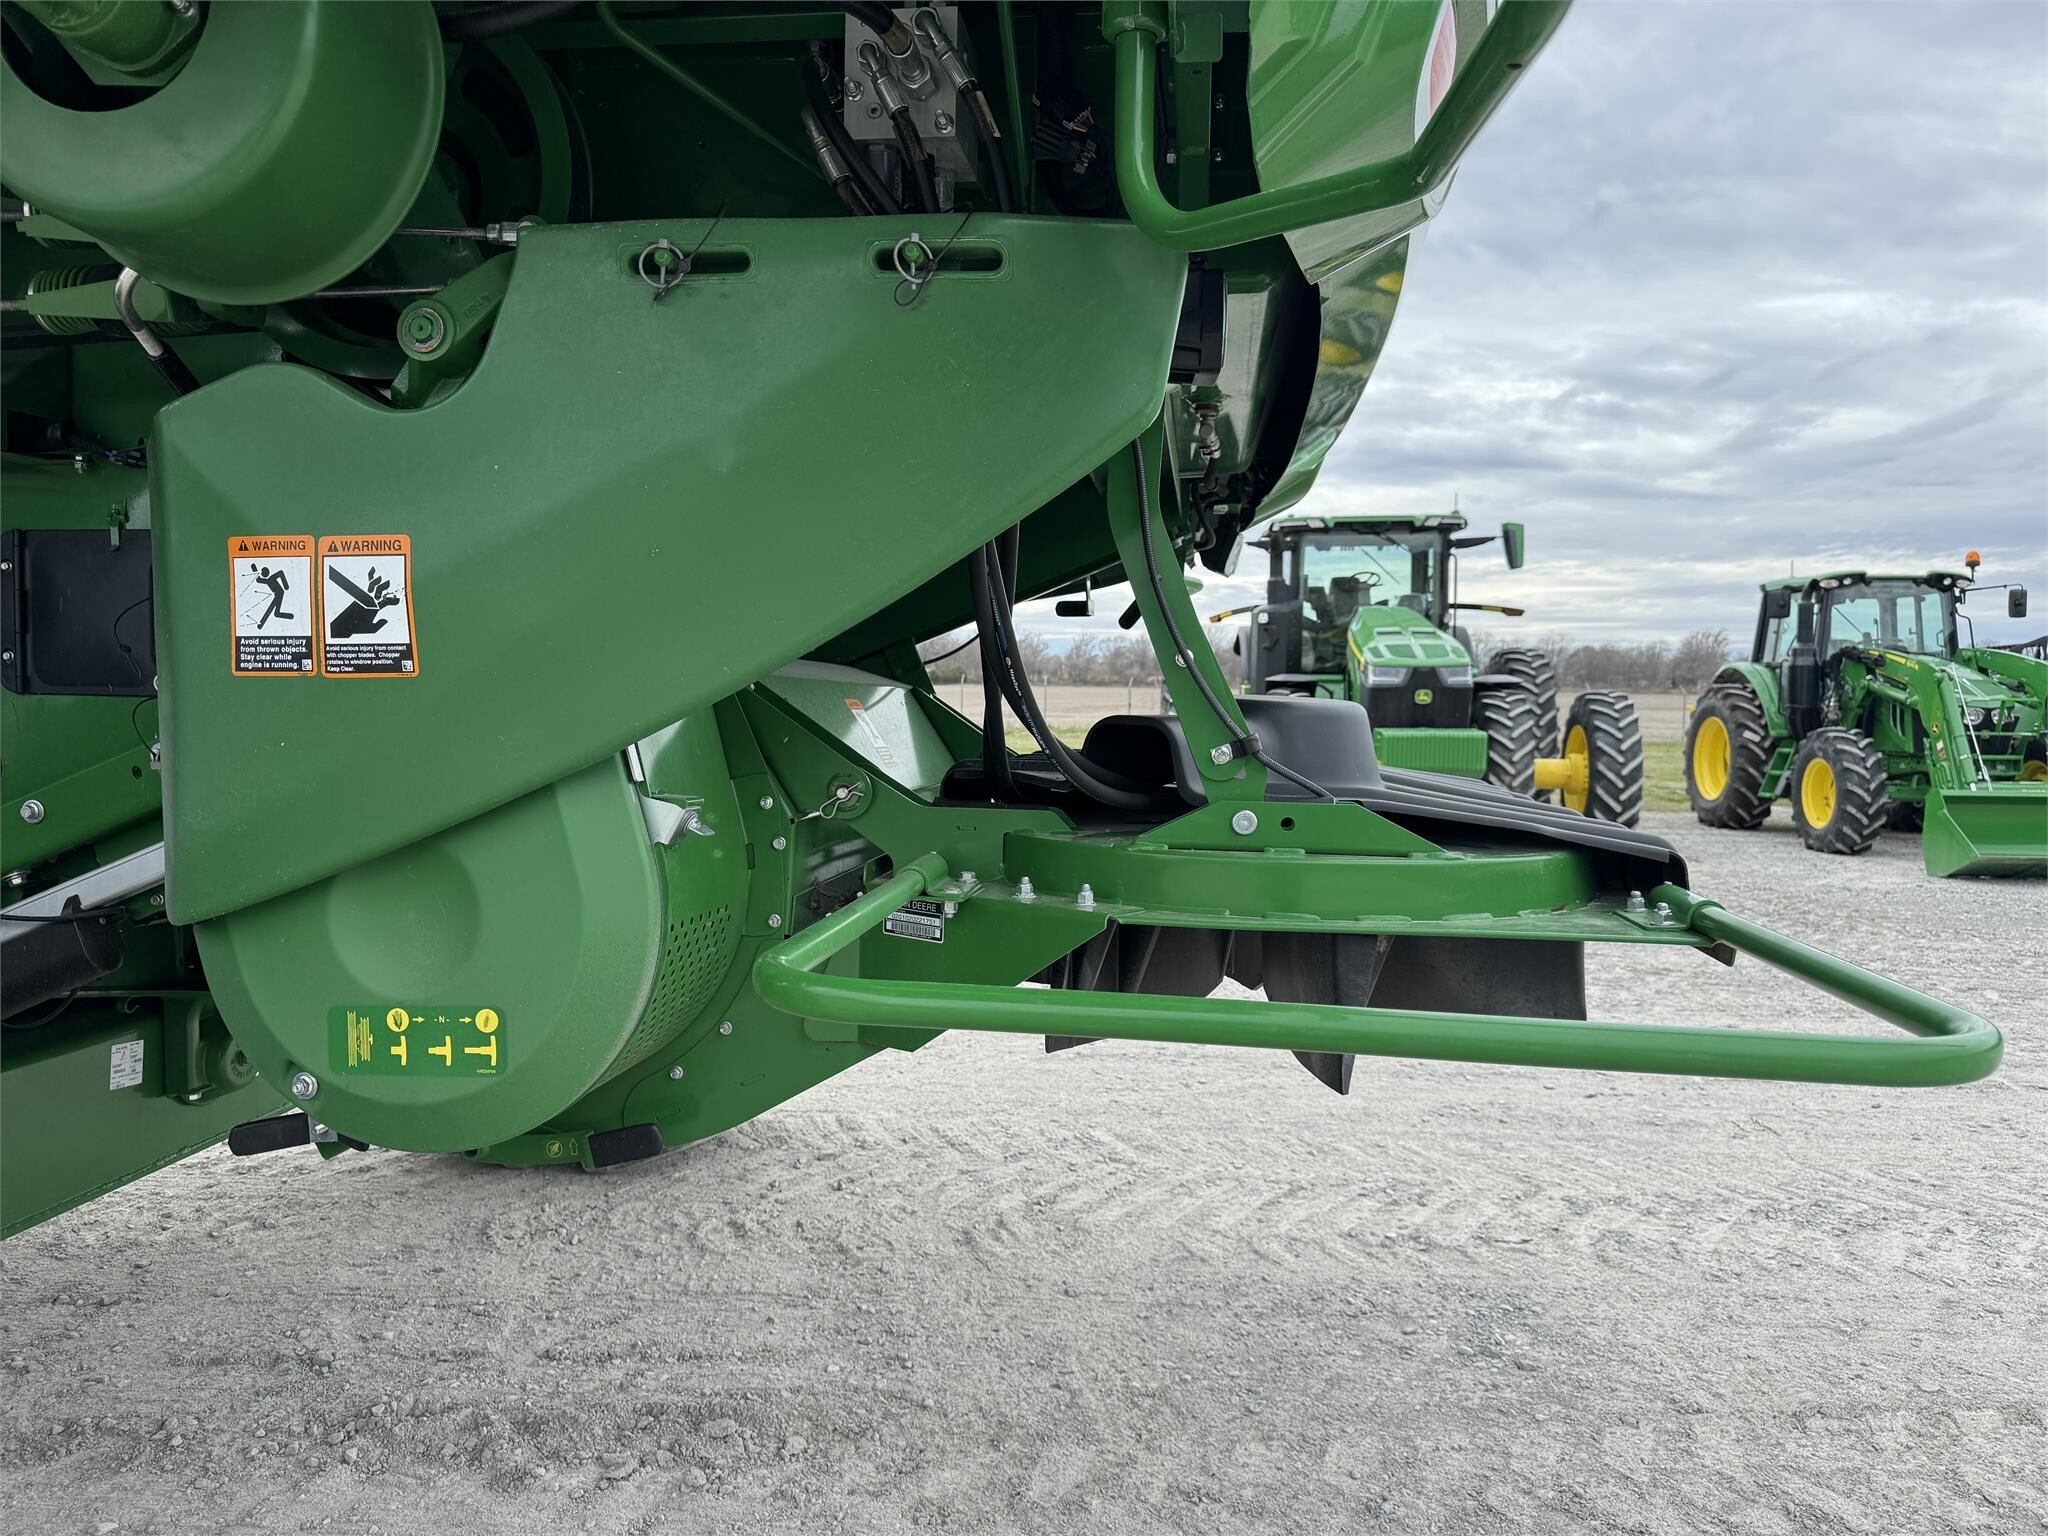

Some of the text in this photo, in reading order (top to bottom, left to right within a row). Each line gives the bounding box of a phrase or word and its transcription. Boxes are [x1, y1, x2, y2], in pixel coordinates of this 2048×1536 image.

[252, 540, 306, 551] WARNING
[341, 540, 402, 551] WARNING
[286, 638, 307, 646] injury
[281, 646, 308, 654] objects.
[240, 653, 255, 661] Stay
[240, 661, 263, 670] engine
[271, 661, 300, 670] running.
[912, 901, 937, 912] DEERE
